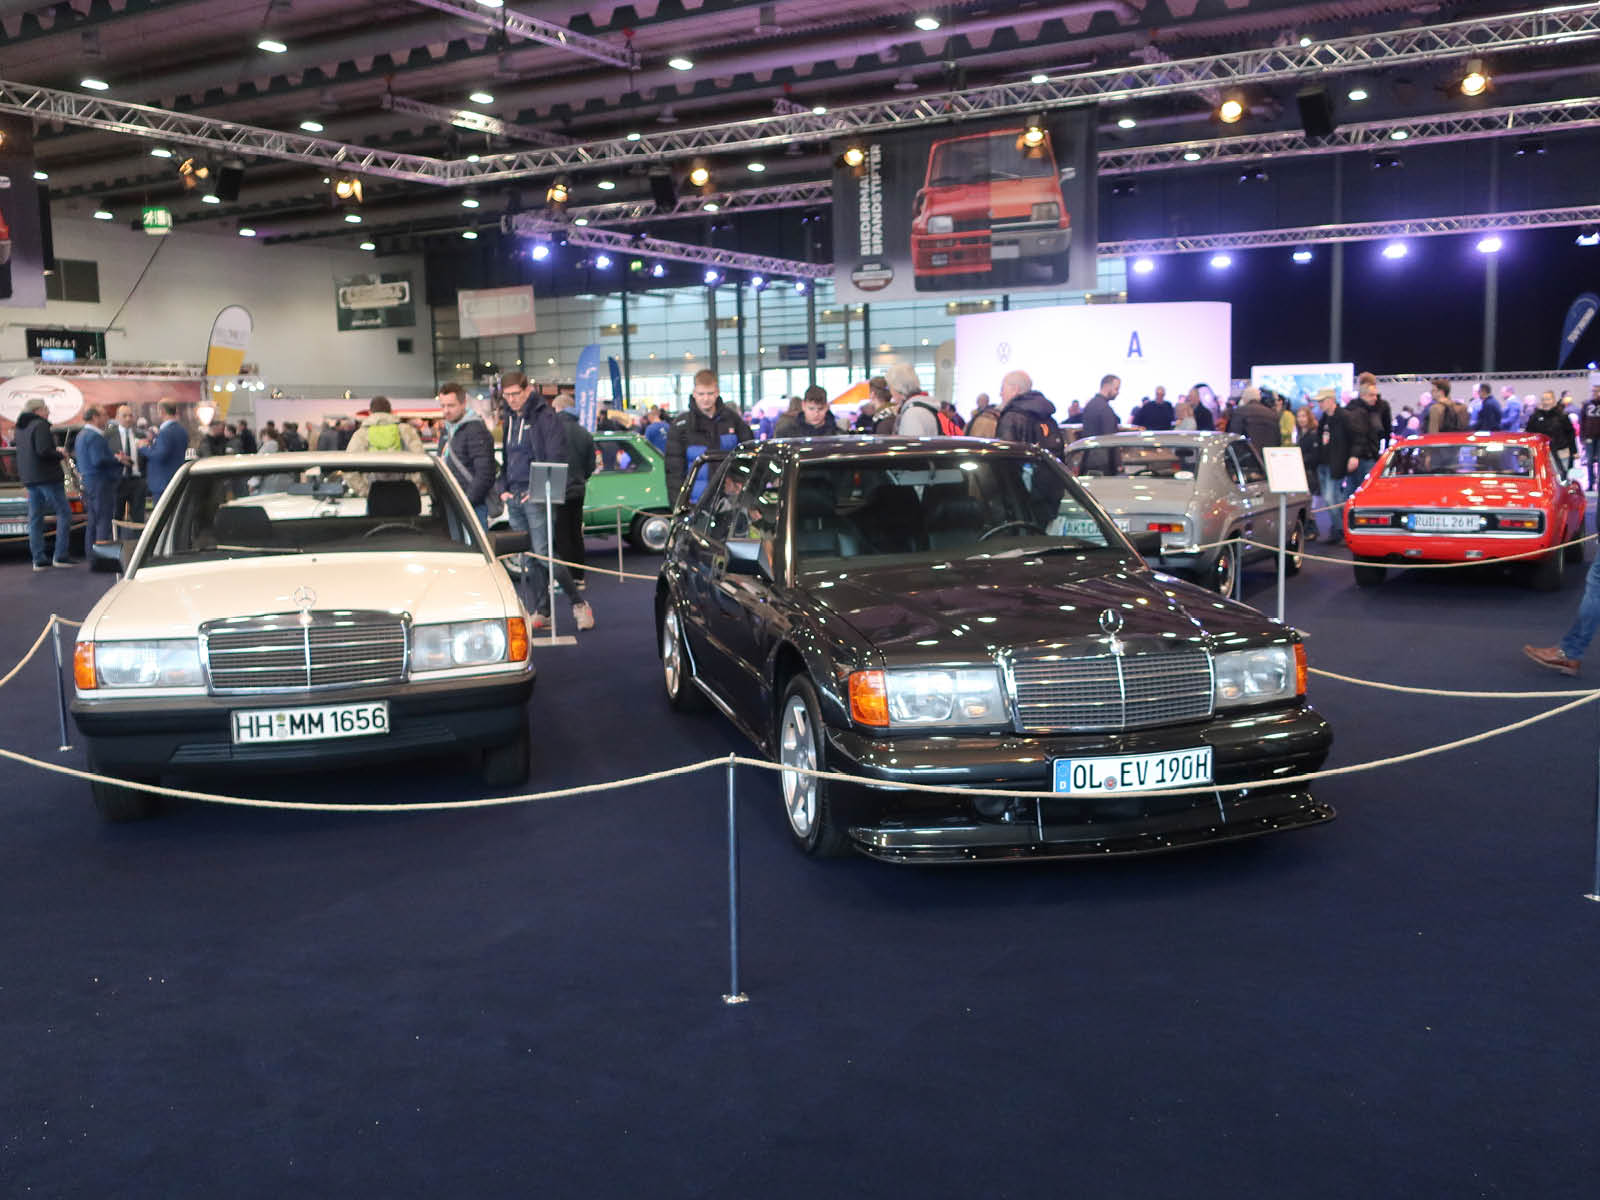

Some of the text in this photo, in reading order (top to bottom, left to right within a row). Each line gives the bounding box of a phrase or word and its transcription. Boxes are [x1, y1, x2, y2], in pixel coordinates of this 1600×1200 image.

[870, 144, 883, 256] BRANDSTIFTER
[36, 336, 61, 348] Halle
[1127, 331, 1142, 358] A
[331, 708, 386, 732] 1656
[1073, 764, 1102, 789] OL
[1120, 760, 1149, 787] EV
[1155, 754, 1209, 784] 190H
